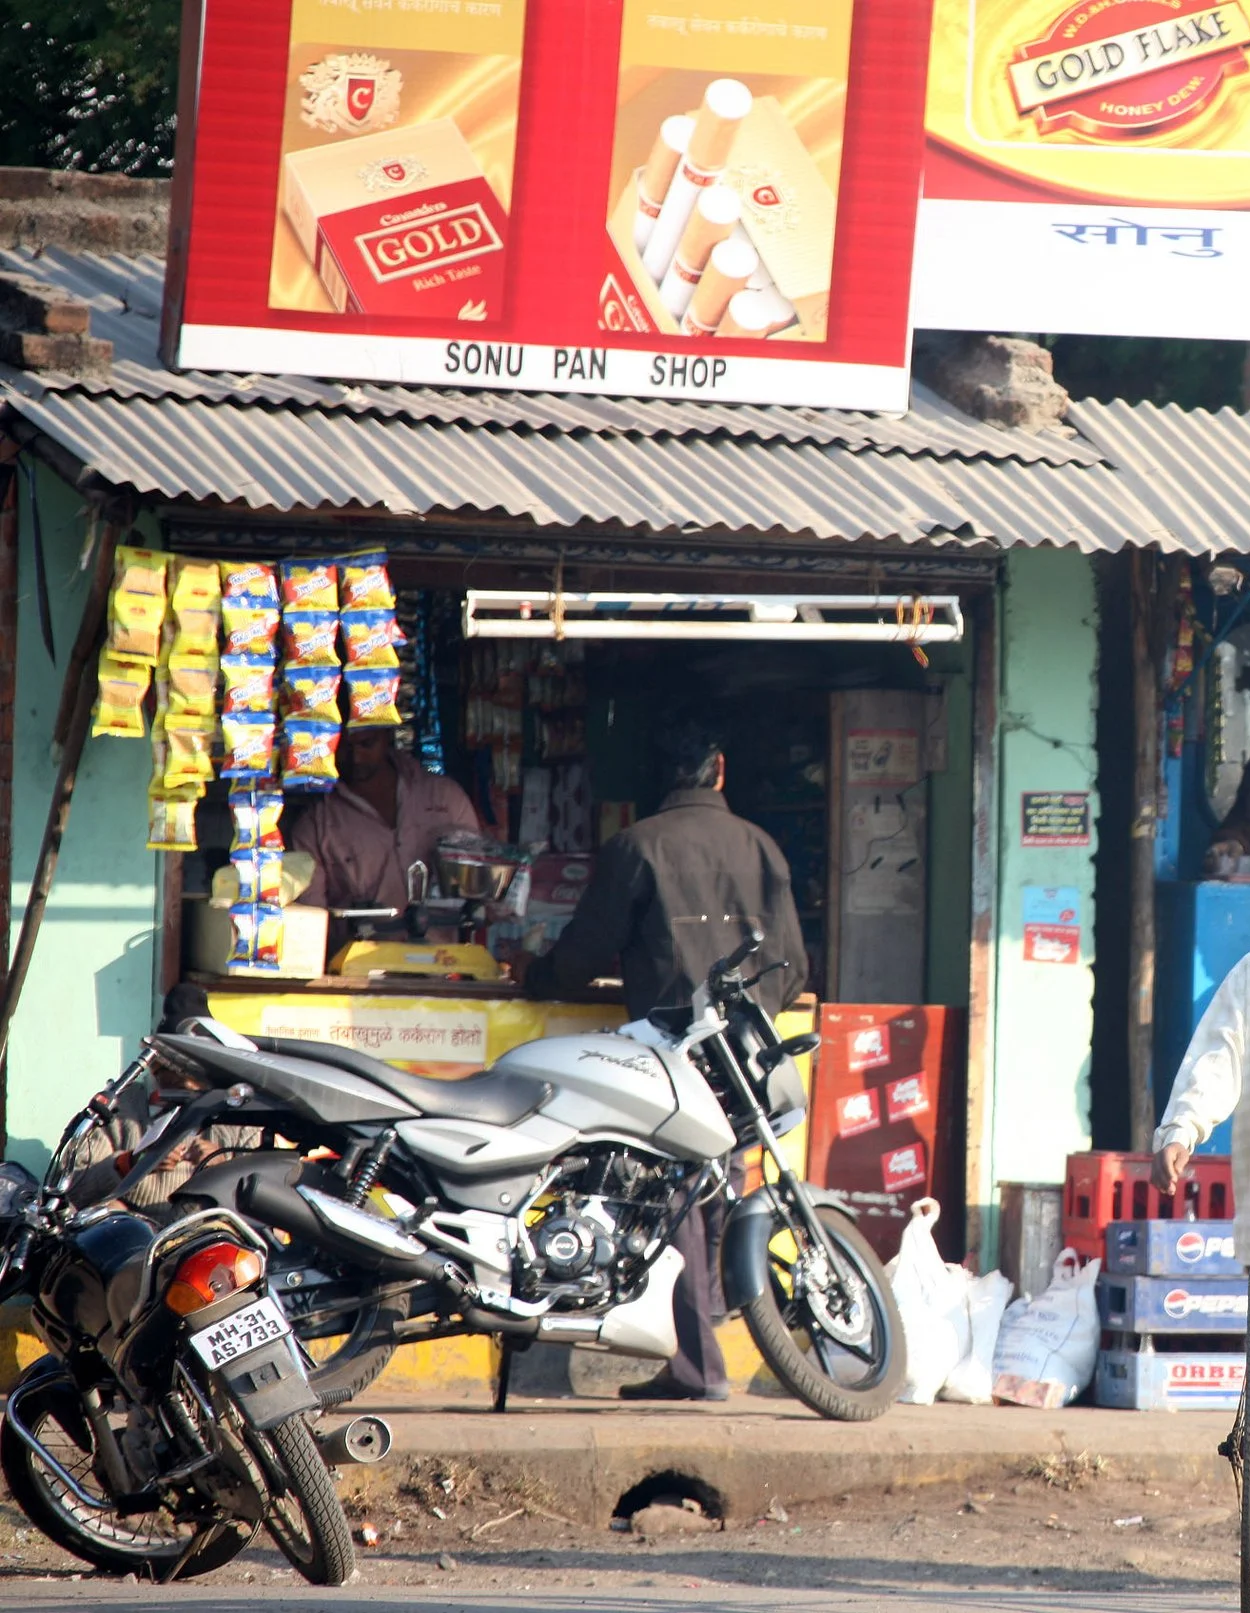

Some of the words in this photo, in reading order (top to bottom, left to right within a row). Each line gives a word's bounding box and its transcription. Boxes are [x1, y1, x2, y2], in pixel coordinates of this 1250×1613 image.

[1035, 42, 1125, 90] GOLD
[1135, 11, 1231, 61] FLAKE
[1101, 102, 1163, 116] HONEY
[376, 218, 482, 267] GOLD
[1051, 218, 1223, 258] सोनु
[412, 274, 446, 292] Rich
[445, 265, 482, 281] Taste
[445, 342, 524, 377] SONU
[554, 348, 607, 380] PAN
[650, 355, 727, 388] SHOP
